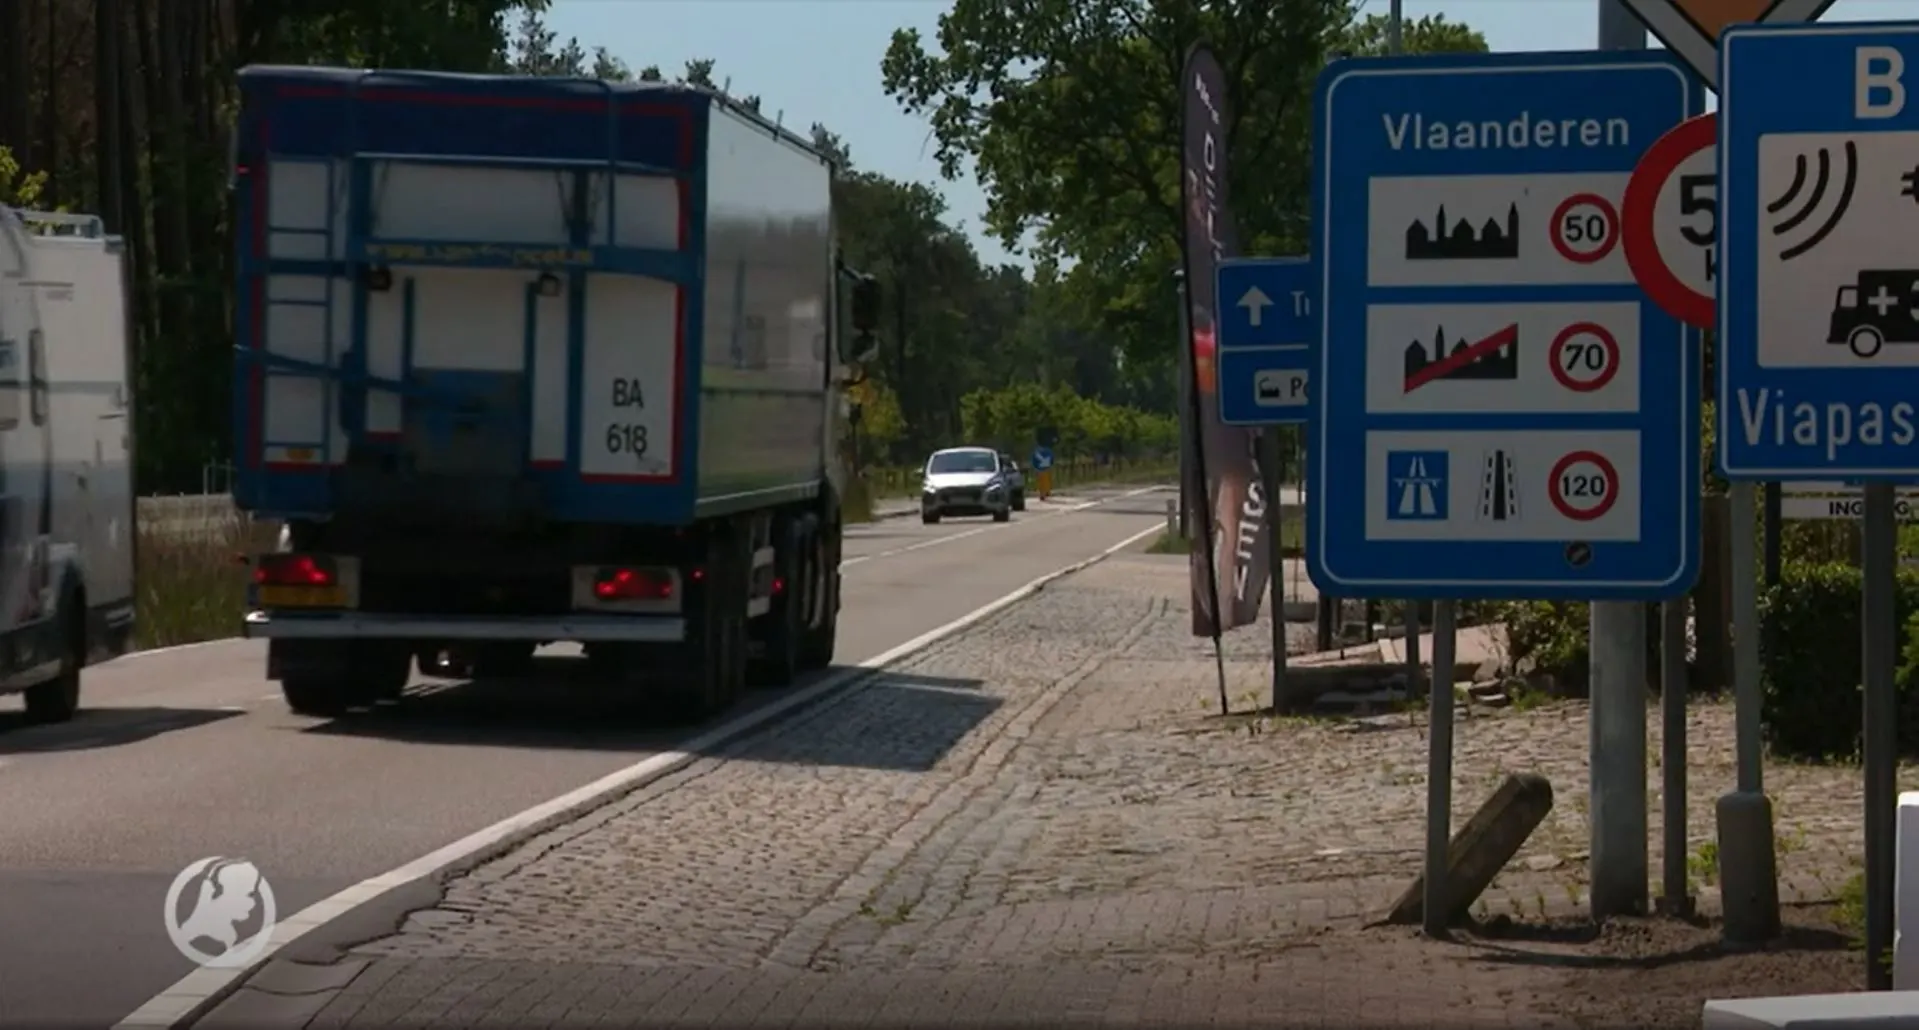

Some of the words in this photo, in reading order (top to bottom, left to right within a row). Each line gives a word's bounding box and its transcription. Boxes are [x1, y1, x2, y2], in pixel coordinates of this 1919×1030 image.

[1854, 46, 1906, 120] B
[1382, 111, 1630, 150] Vlaanderen
[1680, 174, 1717, 246] 5
[1565, 214, 1605, 243] 50
[1566, 343, 1605, 371] 70
[613, 378, 644, 409] BA
[607, 423, 648, 454] 618
[1737, 388, 1916, 460] Viapas
[1562, 475, 1606, 497] 120
